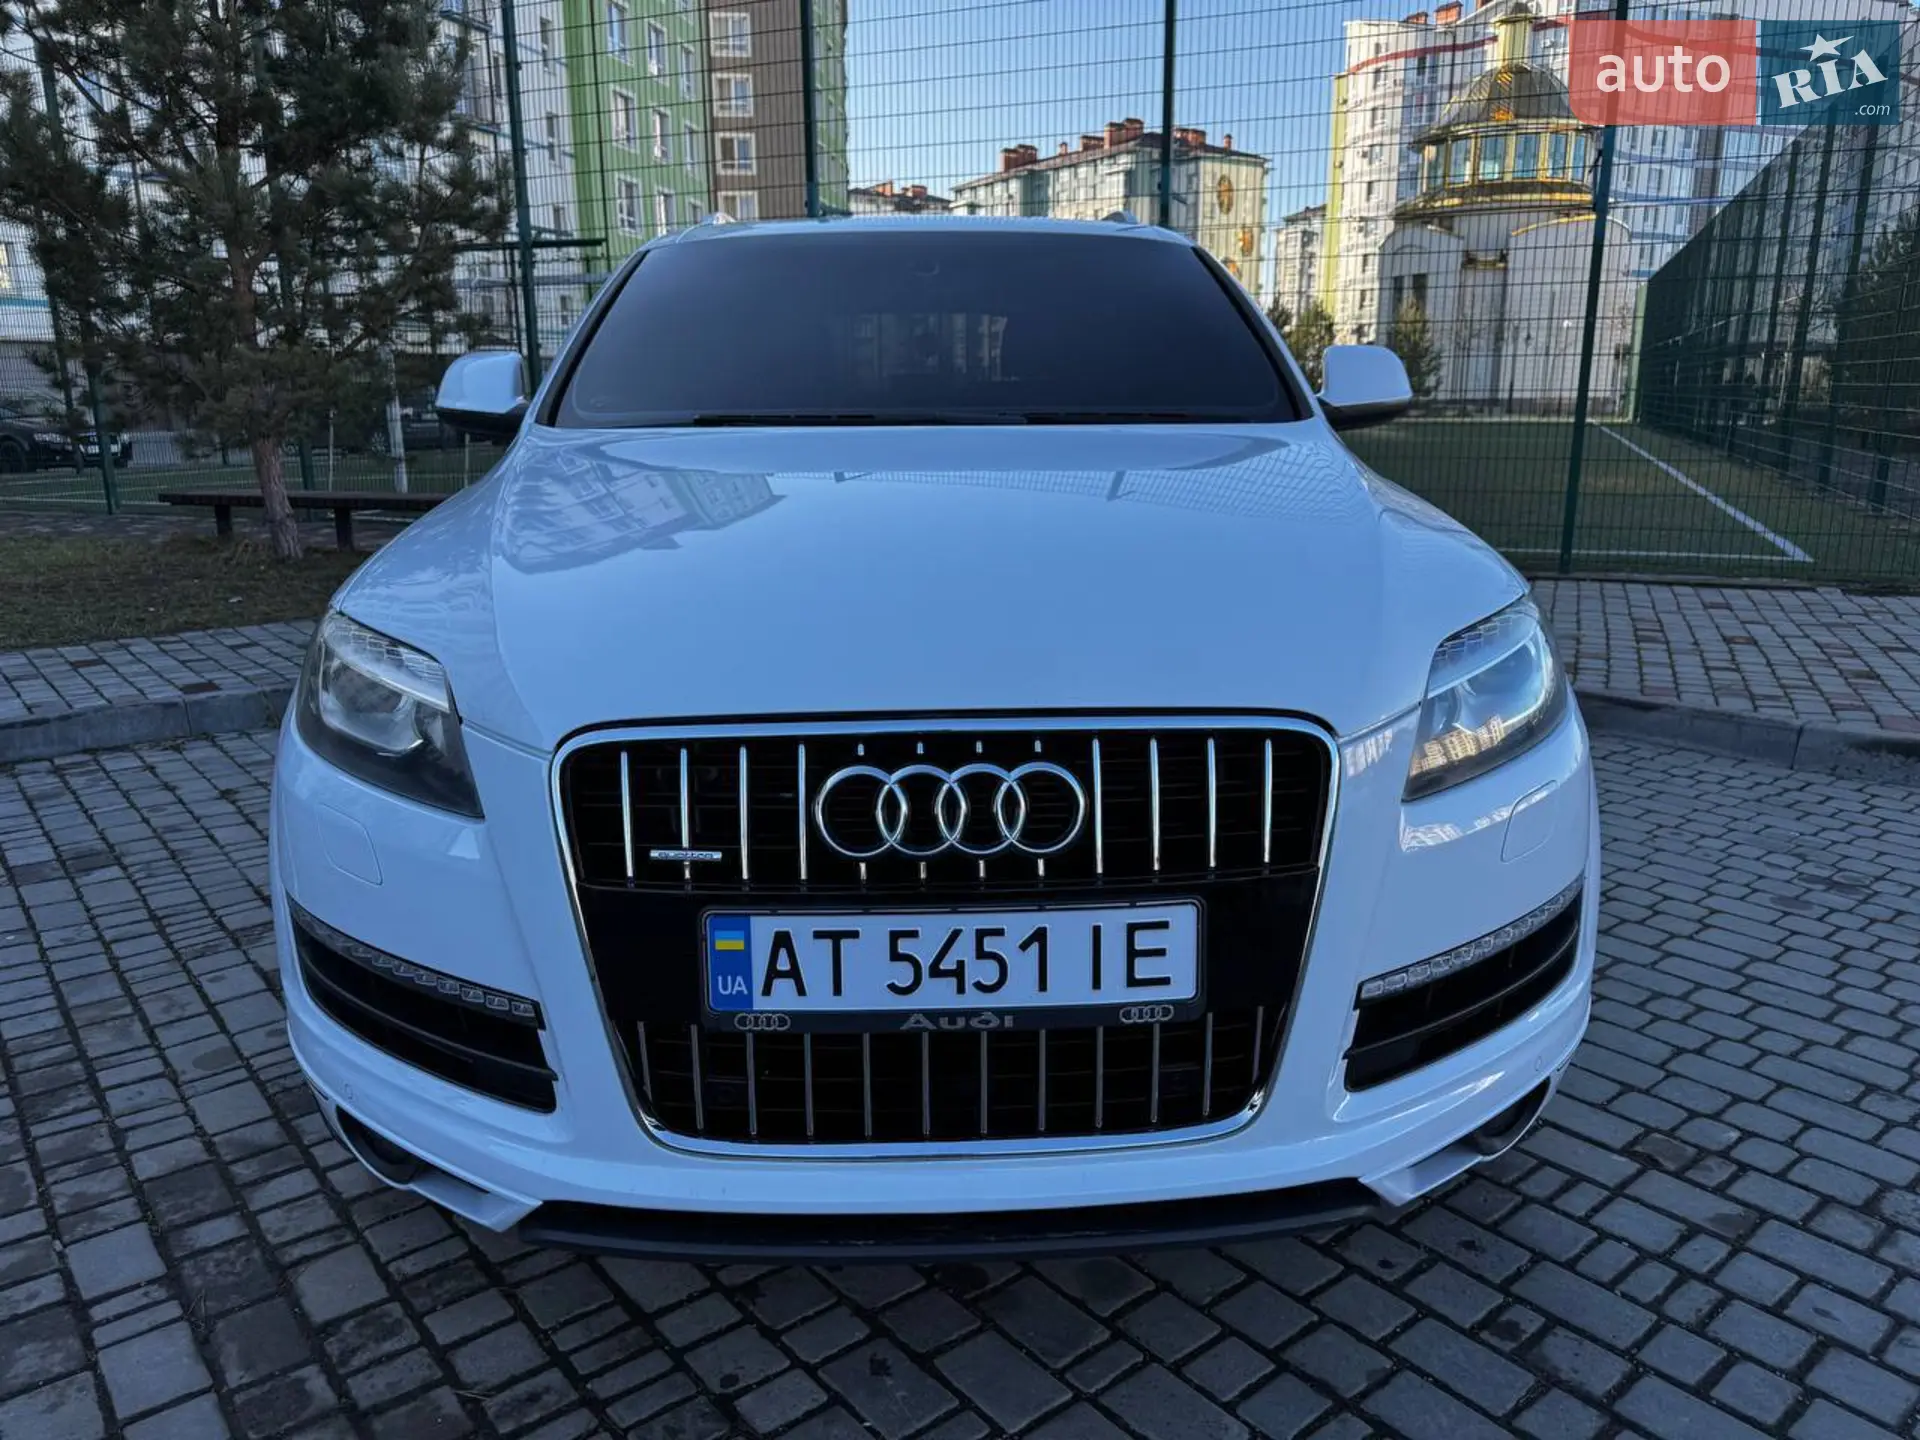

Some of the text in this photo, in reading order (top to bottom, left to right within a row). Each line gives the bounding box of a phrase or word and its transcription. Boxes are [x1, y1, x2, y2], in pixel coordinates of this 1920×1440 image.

[761, 920, 1172, 997] AT 5451 IE
[717, 974, 749, 996] UA
